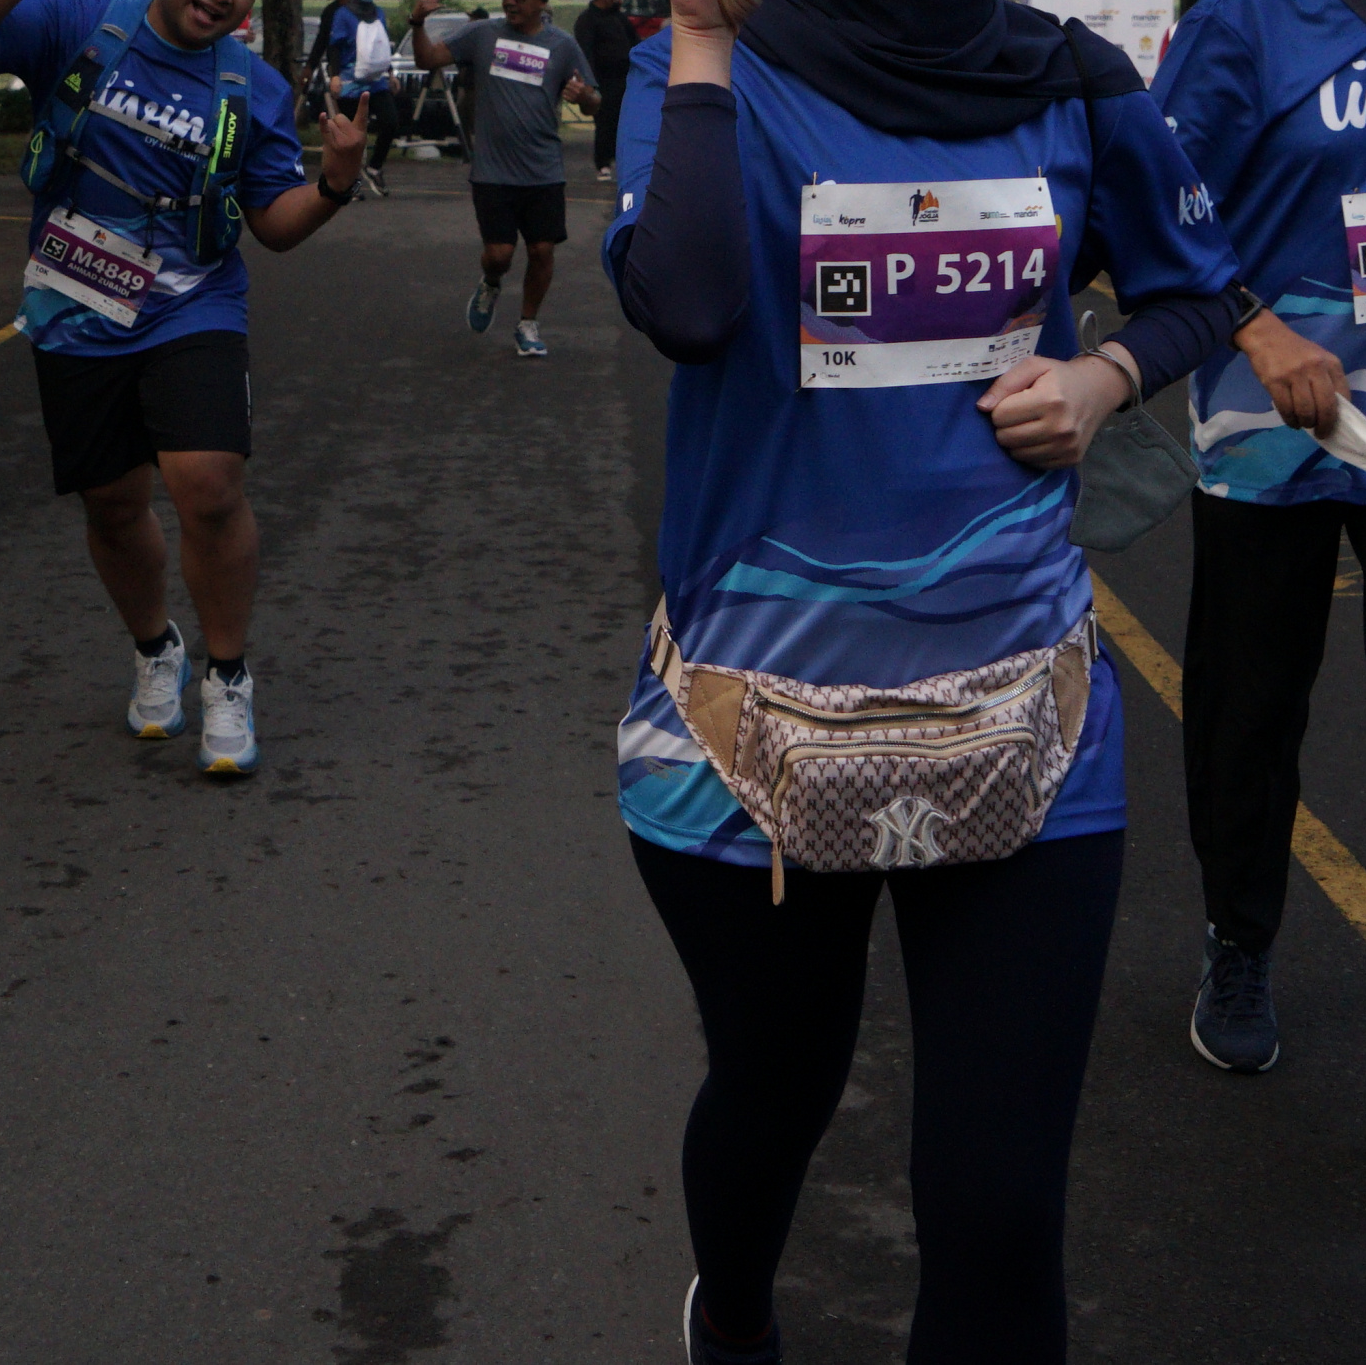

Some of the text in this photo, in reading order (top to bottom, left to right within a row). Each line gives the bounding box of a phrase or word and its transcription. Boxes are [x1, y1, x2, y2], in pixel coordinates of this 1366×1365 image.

[222, 111, 238, 159] AONIJIE
[838, 213, 867, 228] kopra
[1013, 209, 1040, 219] mandiri
[35, 264, 50, 277] 10K
[67, 262, 131, 298] AHMAD ZUBAIDI
[71, 246, 146, 292] M4849
[886, 248, 1047, 295] P 5214
[822, 350, 857, 367] 10K
